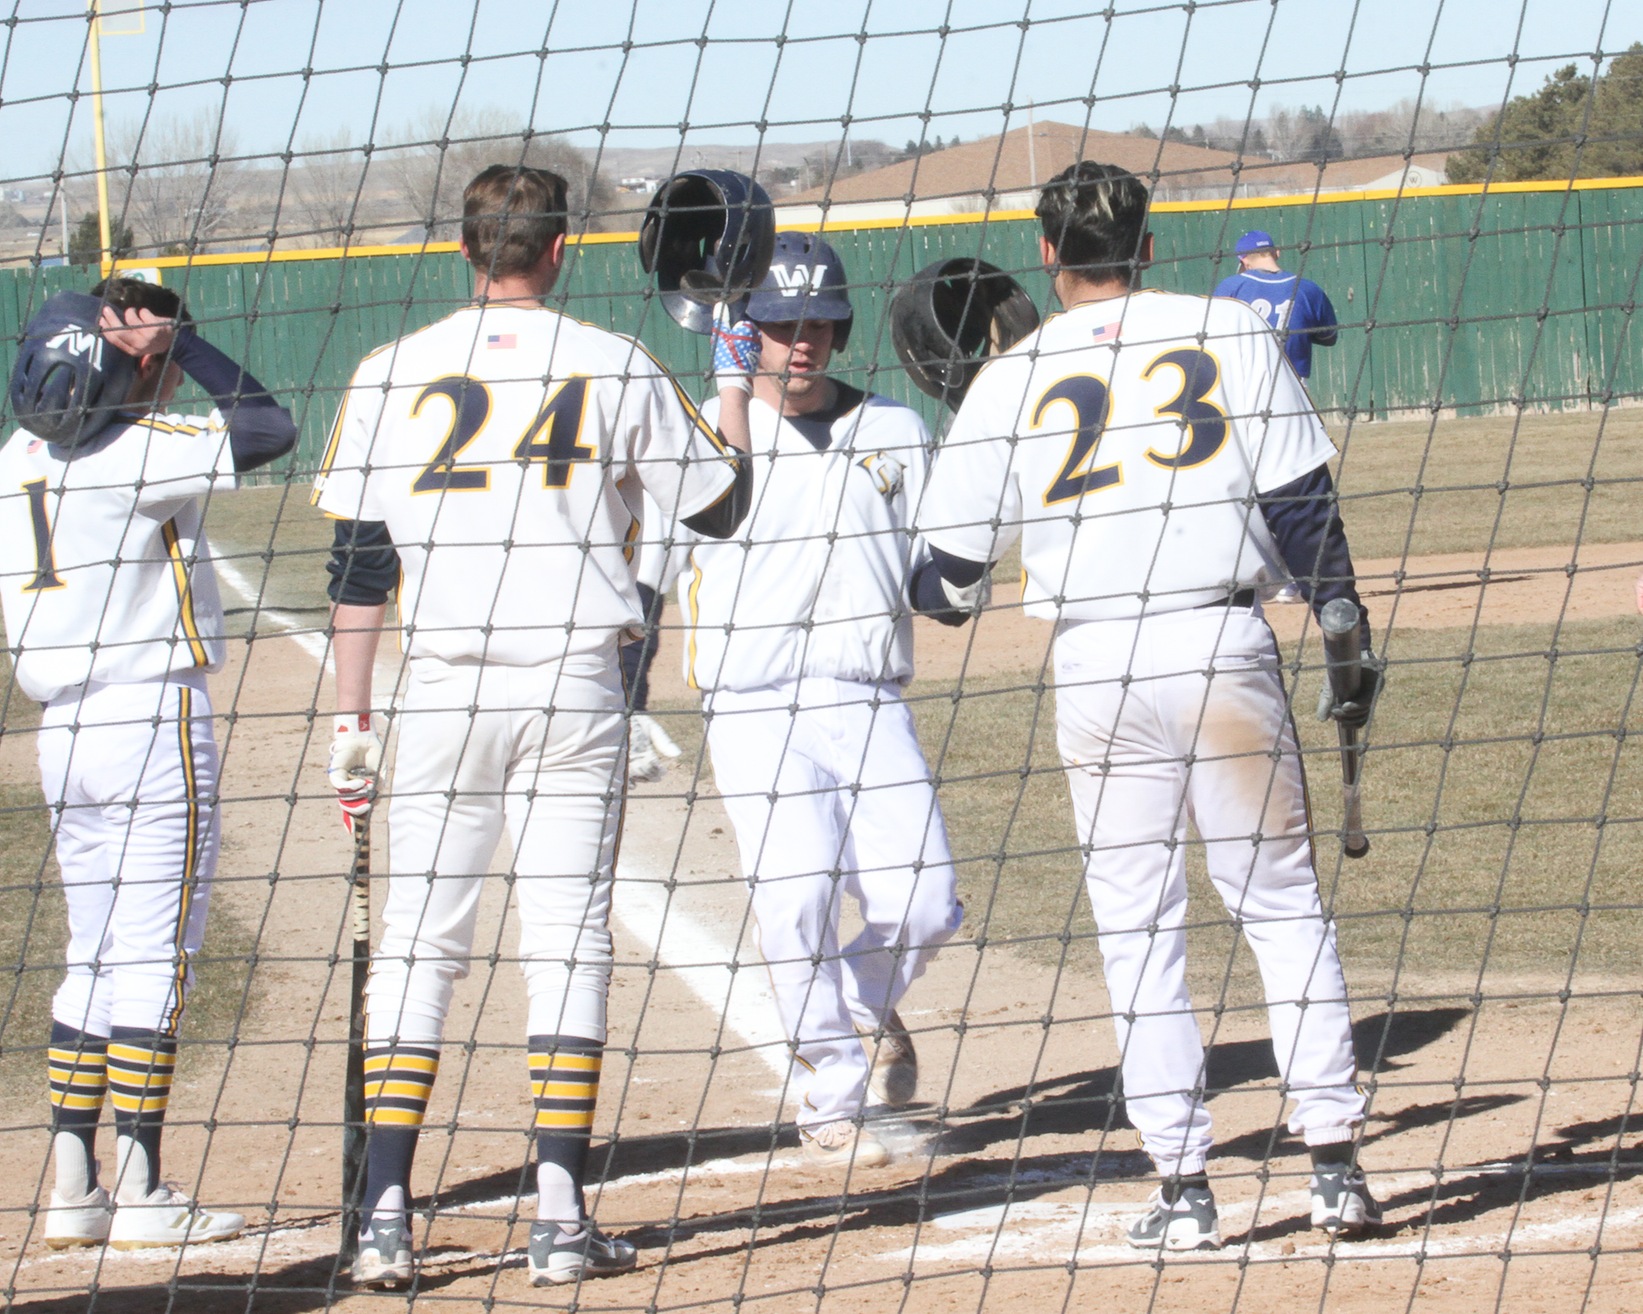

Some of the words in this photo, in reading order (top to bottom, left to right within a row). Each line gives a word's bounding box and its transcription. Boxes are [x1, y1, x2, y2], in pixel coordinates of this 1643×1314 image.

[769, 264, 828, 297] W
[409, 372, 598, 496] 24
[1029, 346, 1230, 507] 23
[20, 475, 68, 594] 1
